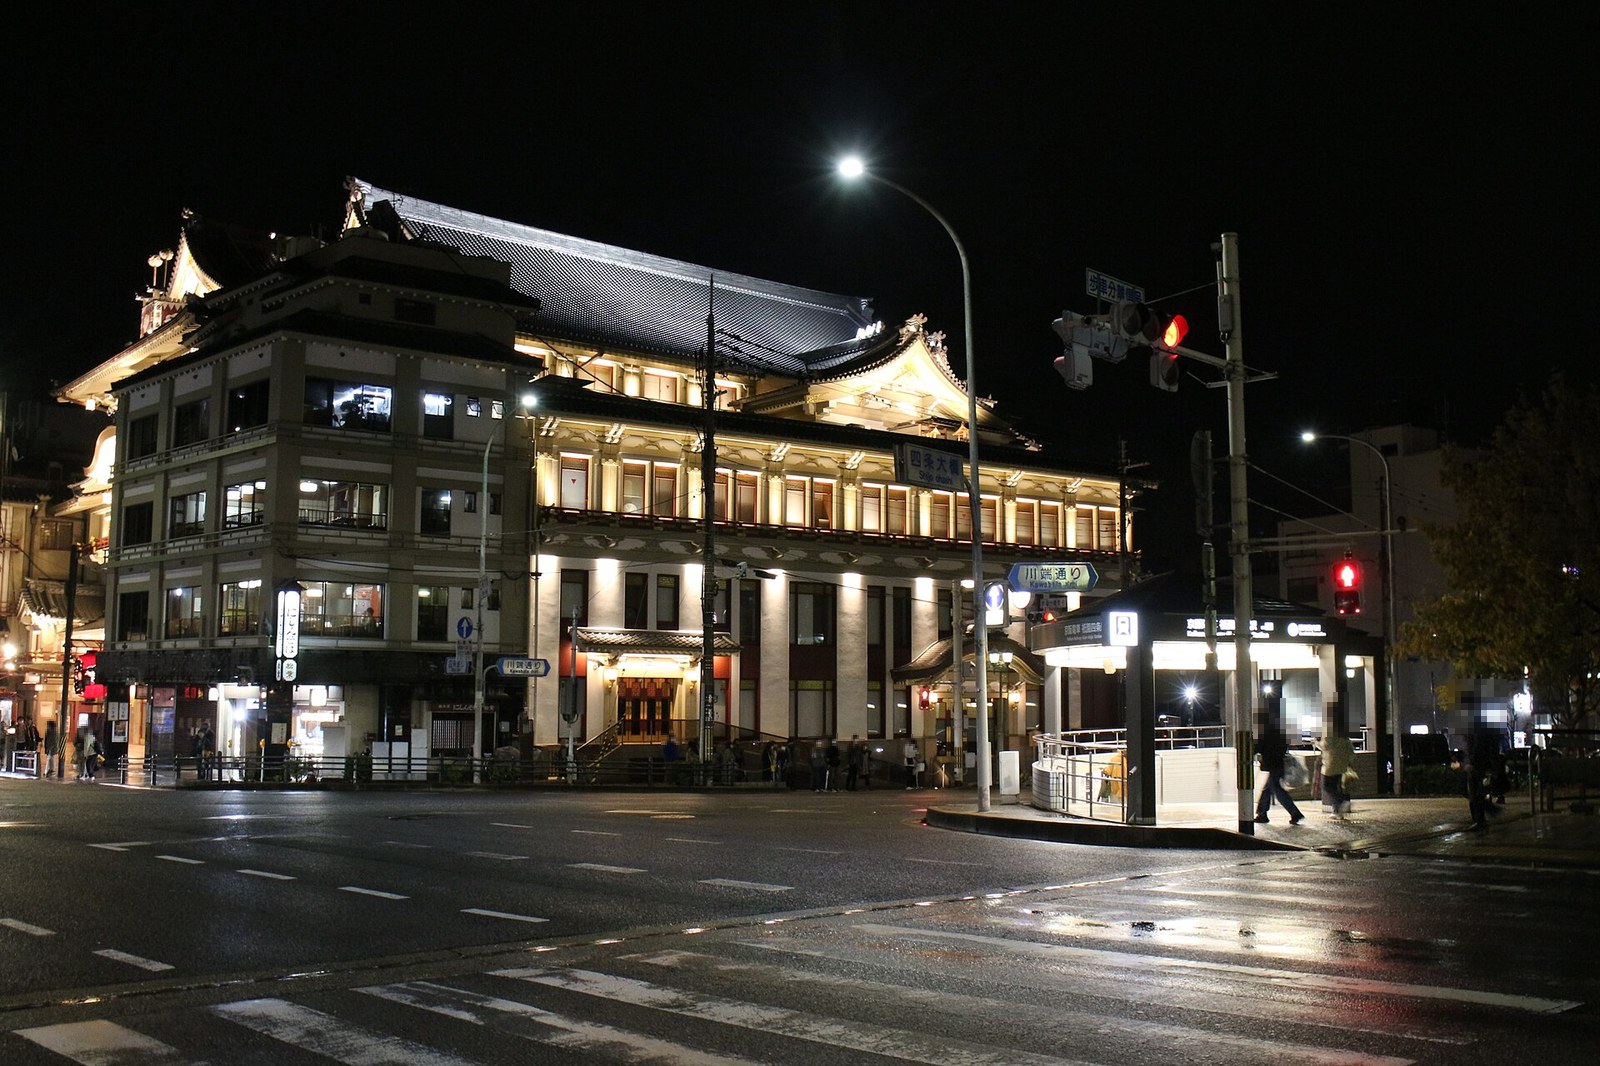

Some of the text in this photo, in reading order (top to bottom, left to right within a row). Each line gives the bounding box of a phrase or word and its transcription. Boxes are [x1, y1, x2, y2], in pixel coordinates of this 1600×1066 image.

[911, 450, 960, 476] 四条大橋
[1025, 567, 1081, 581] 川端通り
[506, 661, 541, 669] 川端通り
